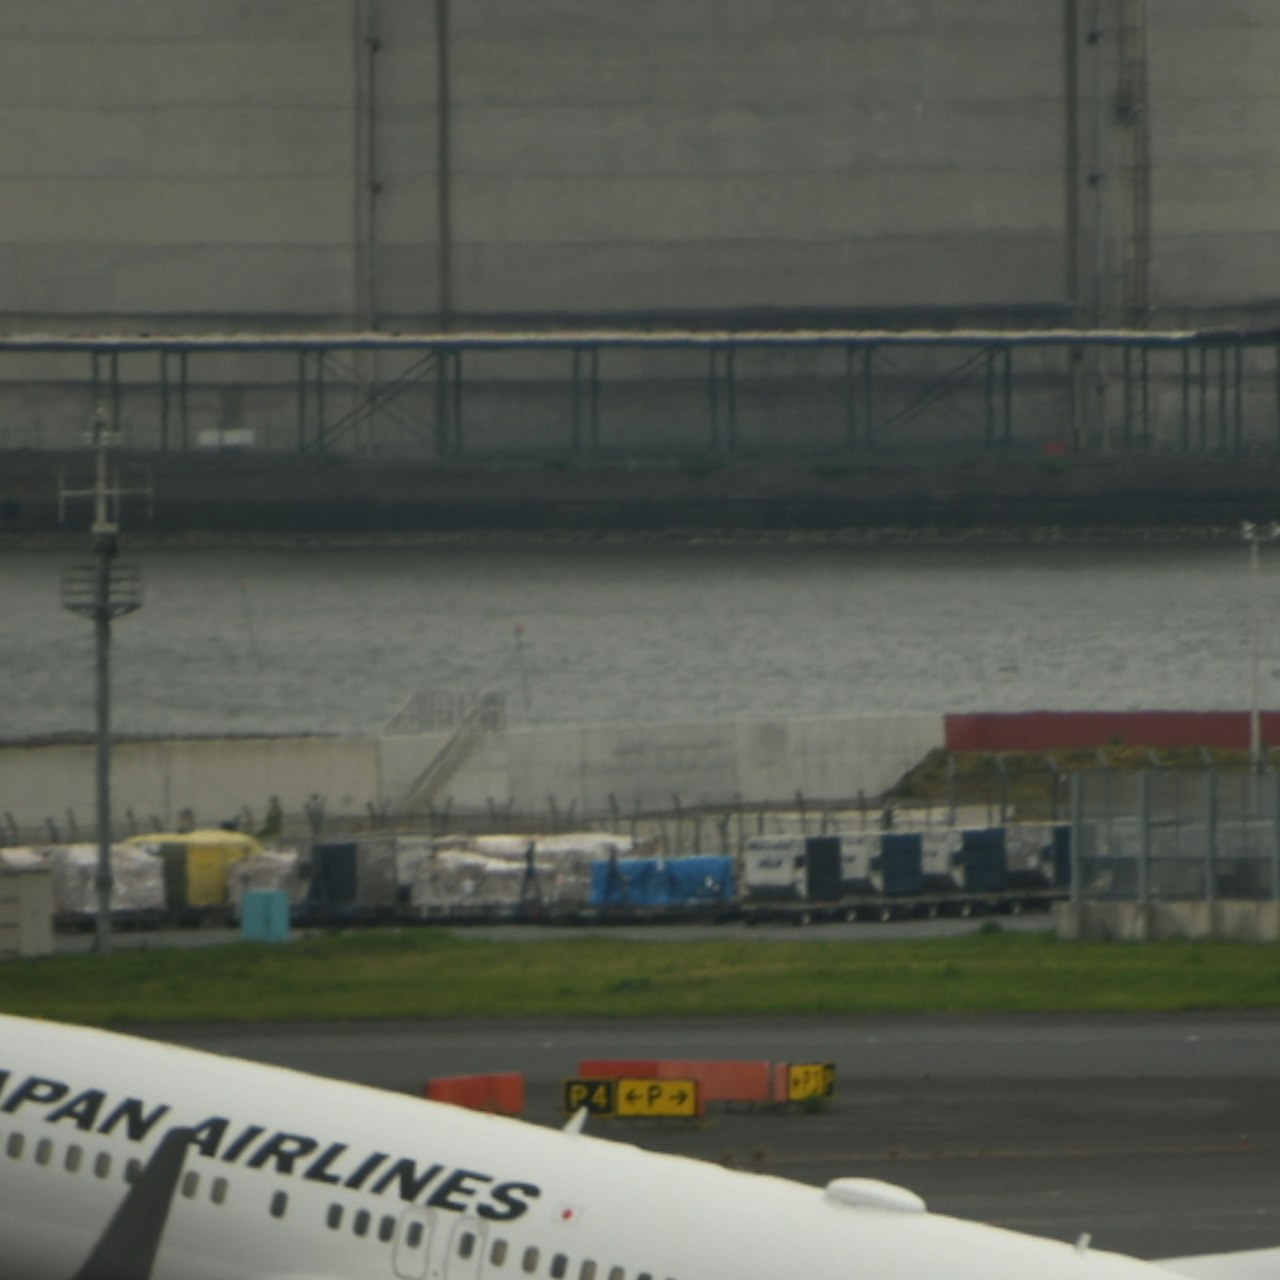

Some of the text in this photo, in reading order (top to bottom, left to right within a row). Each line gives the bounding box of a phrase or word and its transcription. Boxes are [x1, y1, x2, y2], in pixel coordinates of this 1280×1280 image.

[570, 1083, 608, 1109] P4
[647, 1084, 663, 1109] P
[182, 1116, 541, 1221] AIRLINES
